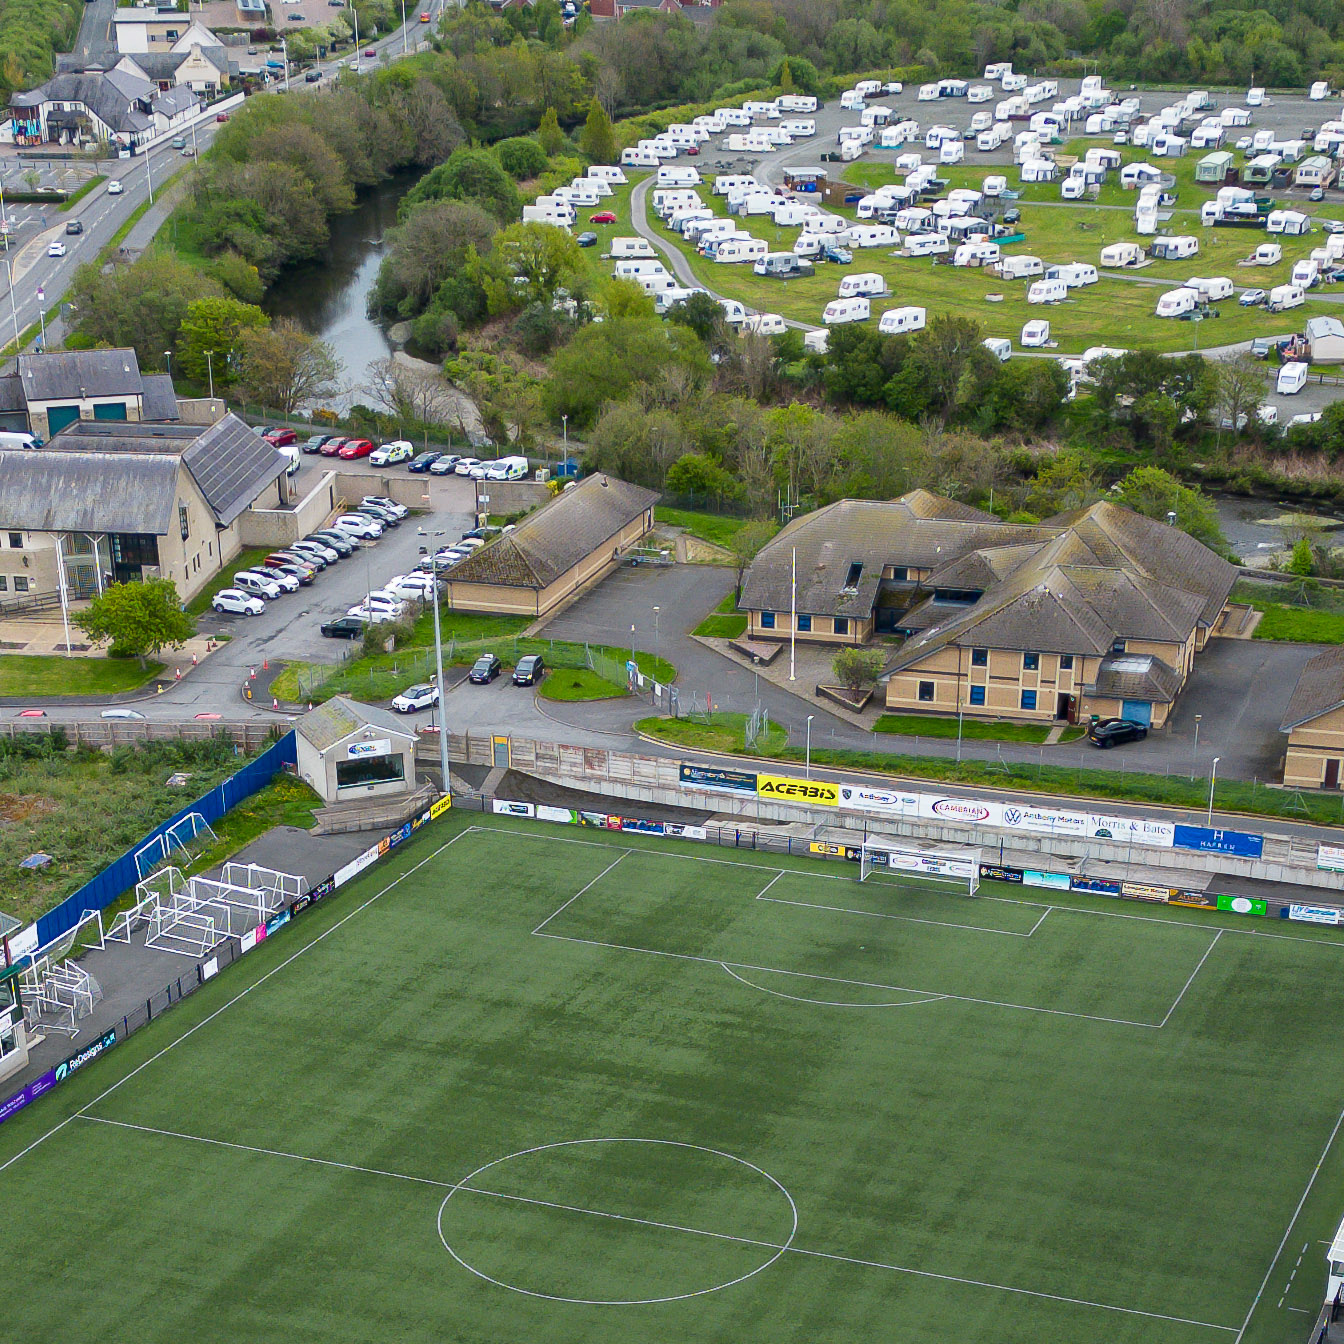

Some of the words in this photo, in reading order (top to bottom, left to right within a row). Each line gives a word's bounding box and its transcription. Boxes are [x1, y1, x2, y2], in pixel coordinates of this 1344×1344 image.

[938, 803, 983, 815] CAMBRIAN
[1023, 811, 1056, 823] Anthony
[1057, 816, 1085, 825] Motors
[1091, 816, 1126, 830] Morris
[1129, 821, 1139, 832] &
[1143, 823, 1173, 835] Bates
